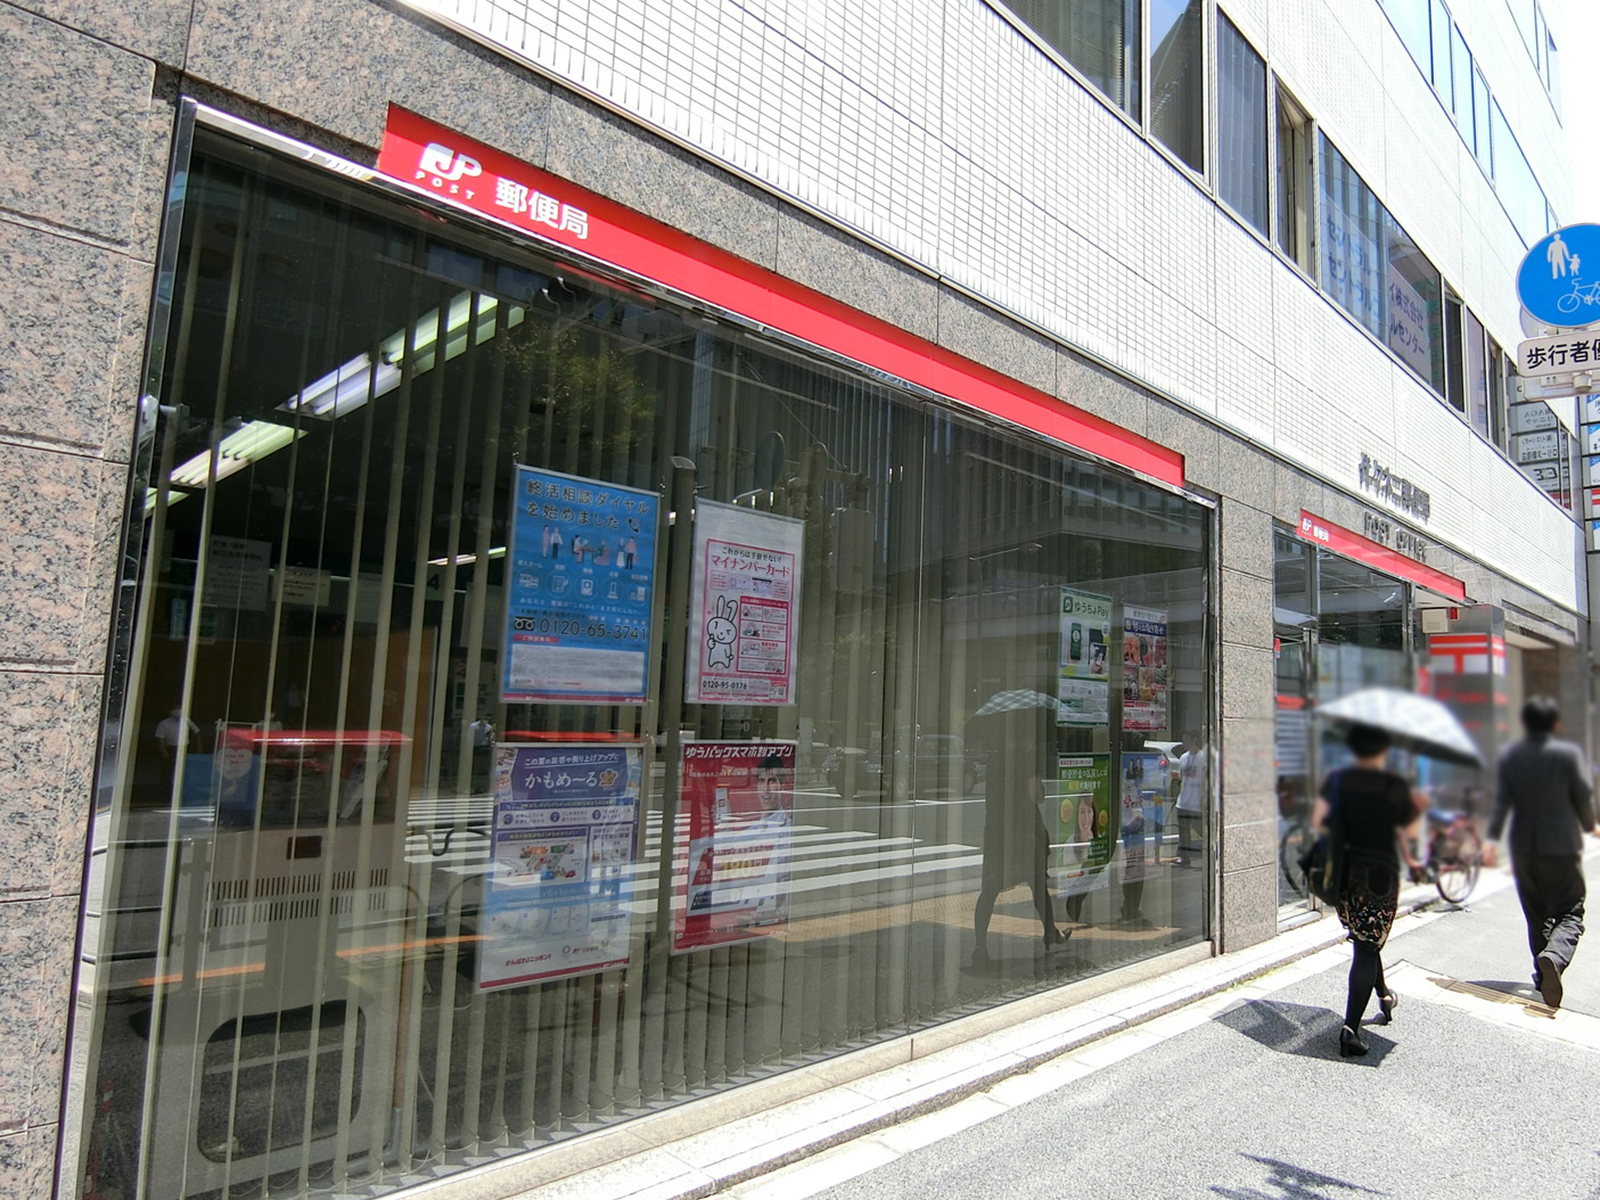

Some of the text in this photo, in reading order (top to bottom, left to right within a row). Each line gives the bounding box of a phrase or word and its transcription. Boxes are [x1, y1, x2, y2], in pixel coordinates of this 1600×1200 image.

[415, 170, 475, 200] POST
[495, 176, 589, 239] 郵便局
[527, 479, 650, 514] 終活相談ダイヤル
[527, 501, 620, 530] を始めました
[1364, 511, 1390, 546] POST
[711, 554, 790, 578] マイナンバーカード
[1074, 601, 1110, 620] ゆうちょPay
[539, 618, 647, 641] 0120-65-3741
[685, 745, 793, 759] ゆうパックスマホ割アプリ
